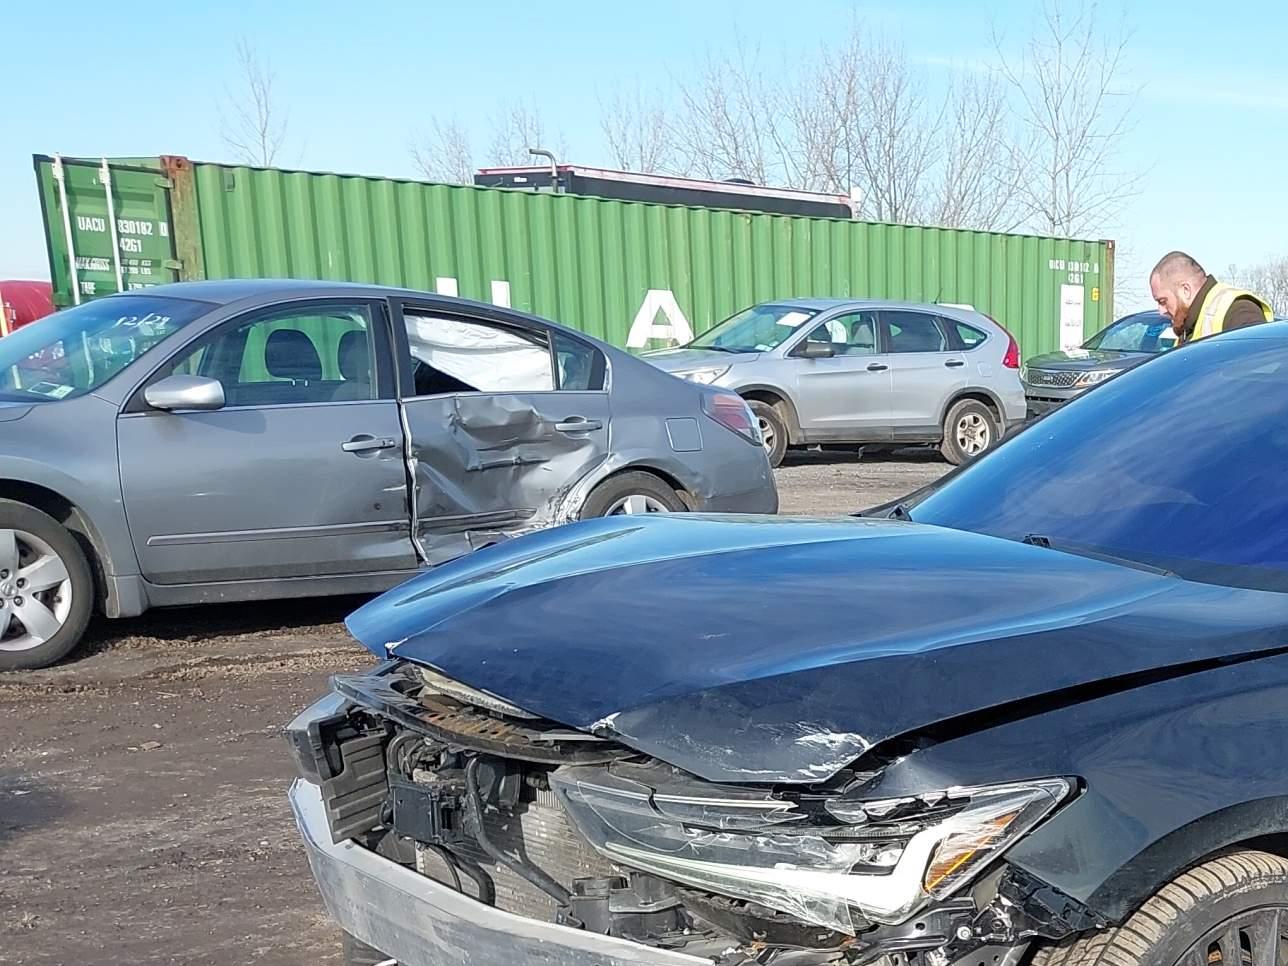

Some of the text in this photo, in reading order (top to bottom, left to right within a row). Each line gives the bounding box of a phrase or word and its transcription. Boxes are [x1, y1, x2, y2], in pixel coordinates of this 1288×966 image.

[77, 216, 105, 233] UACU
[117, 219, 153, 236] 830182
[626, 289, 694, 348] A
